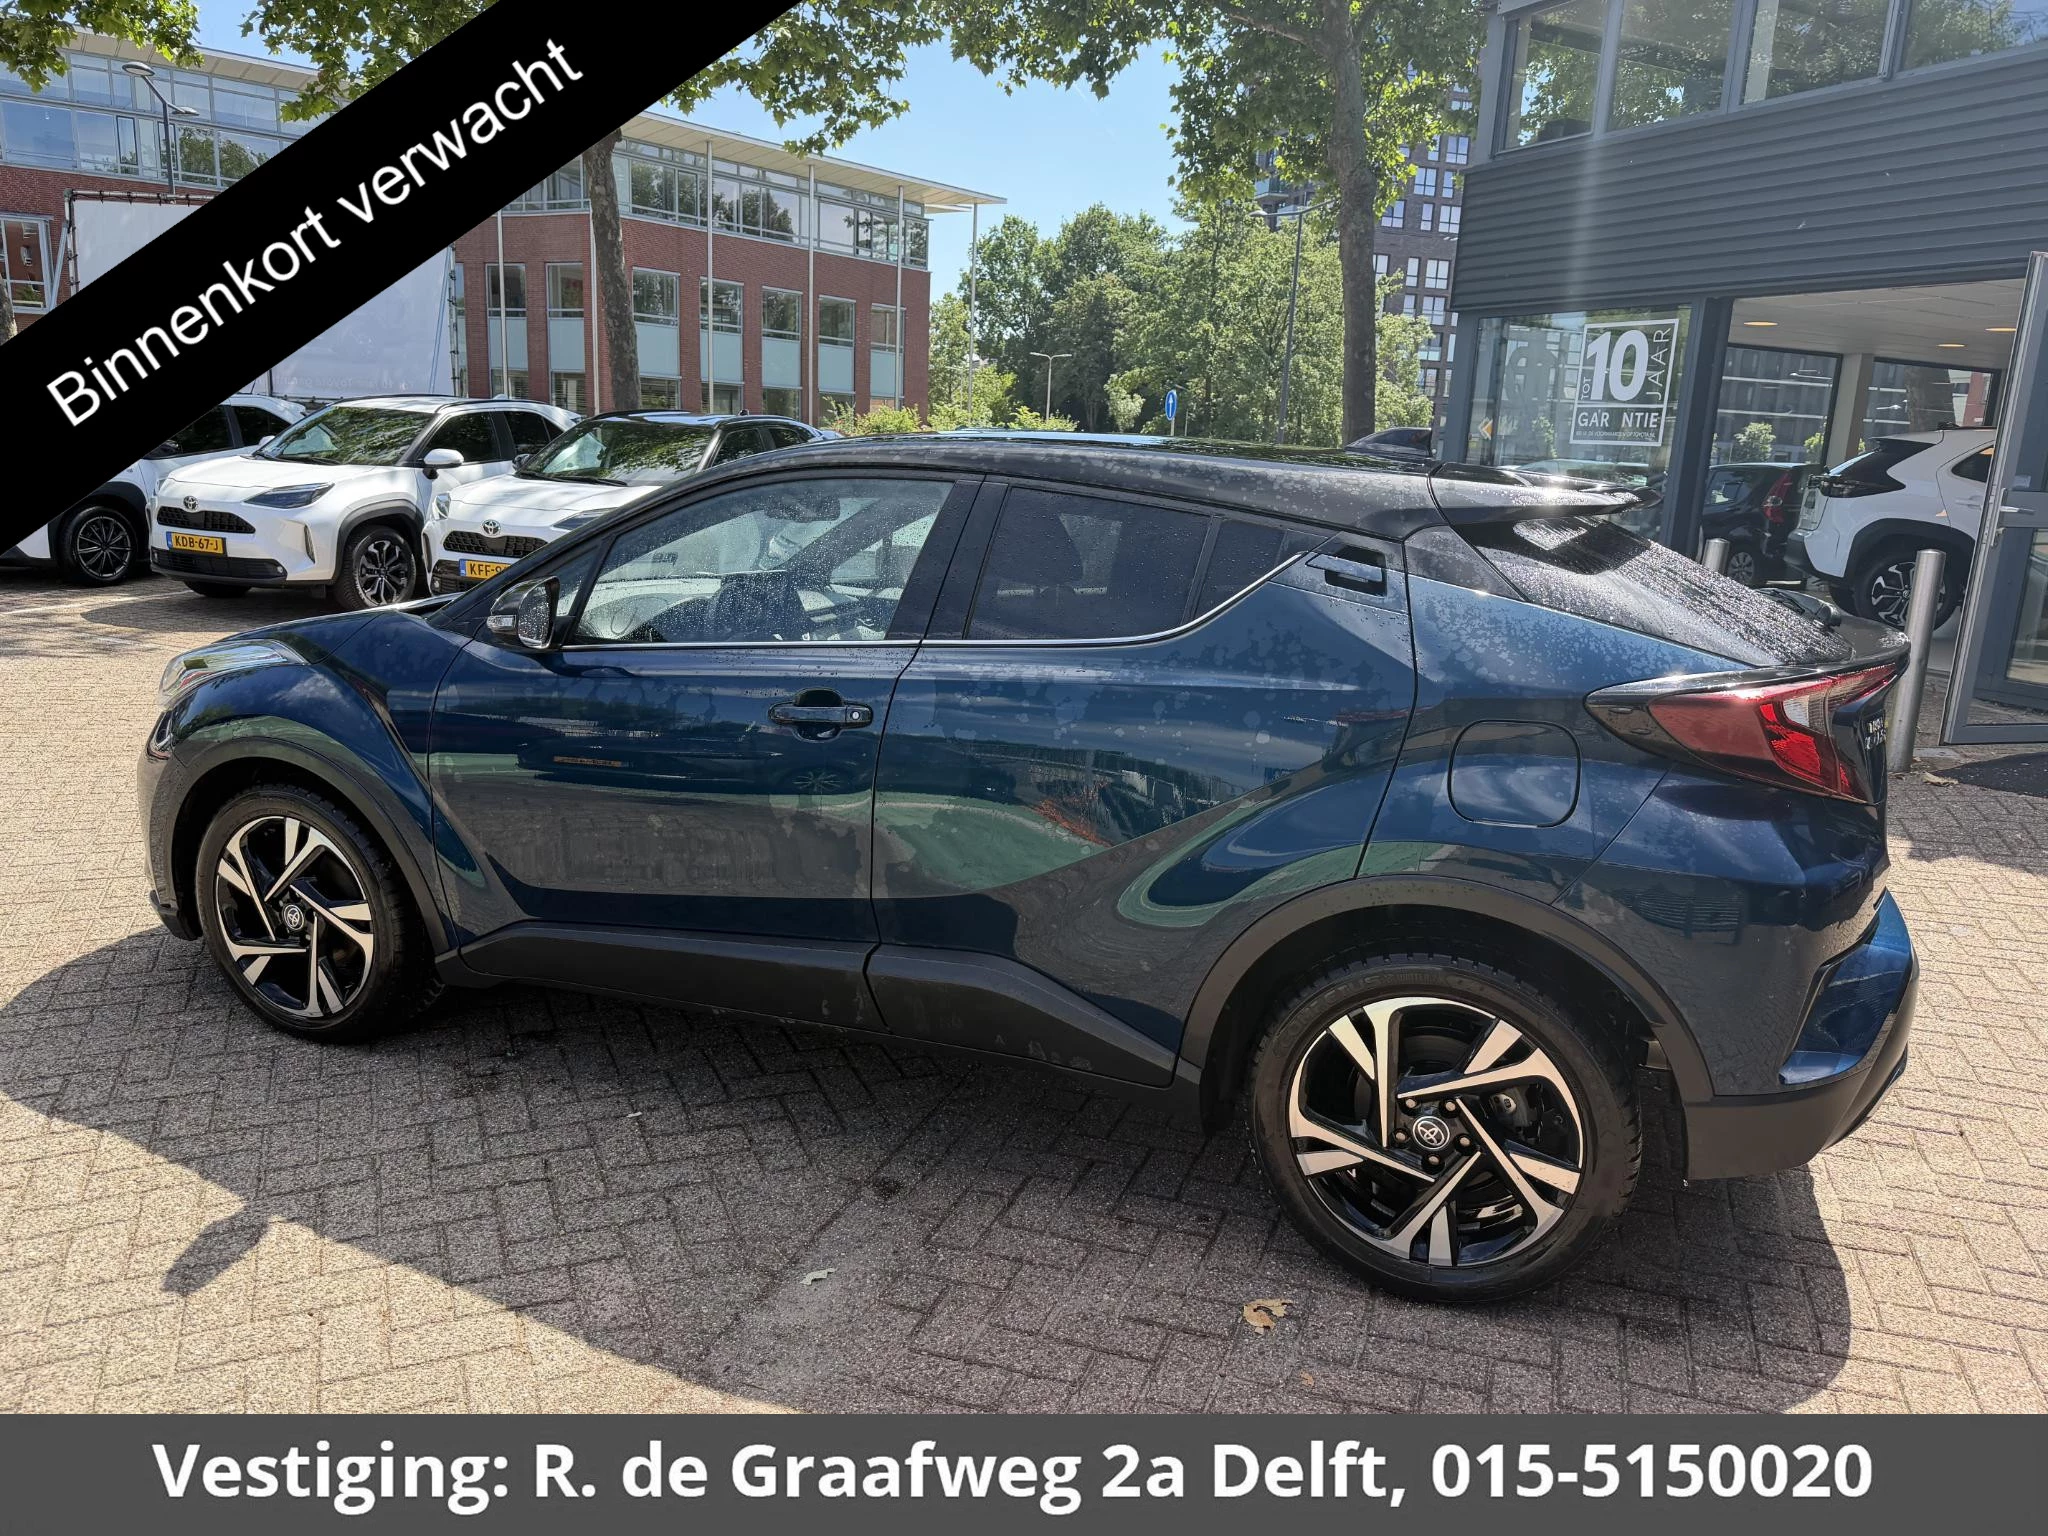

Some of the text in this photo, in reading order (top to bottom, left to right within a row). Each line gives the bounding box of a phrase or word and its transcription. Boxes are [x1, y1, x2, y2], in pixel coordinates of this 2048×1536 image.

[1580, 376, 1592, 400] TOT
[1586, 329, 1649, 402] 10
[1645, 327, 1671, 401] JAAR
[174, 535, 219, 551] KDB-67-J
